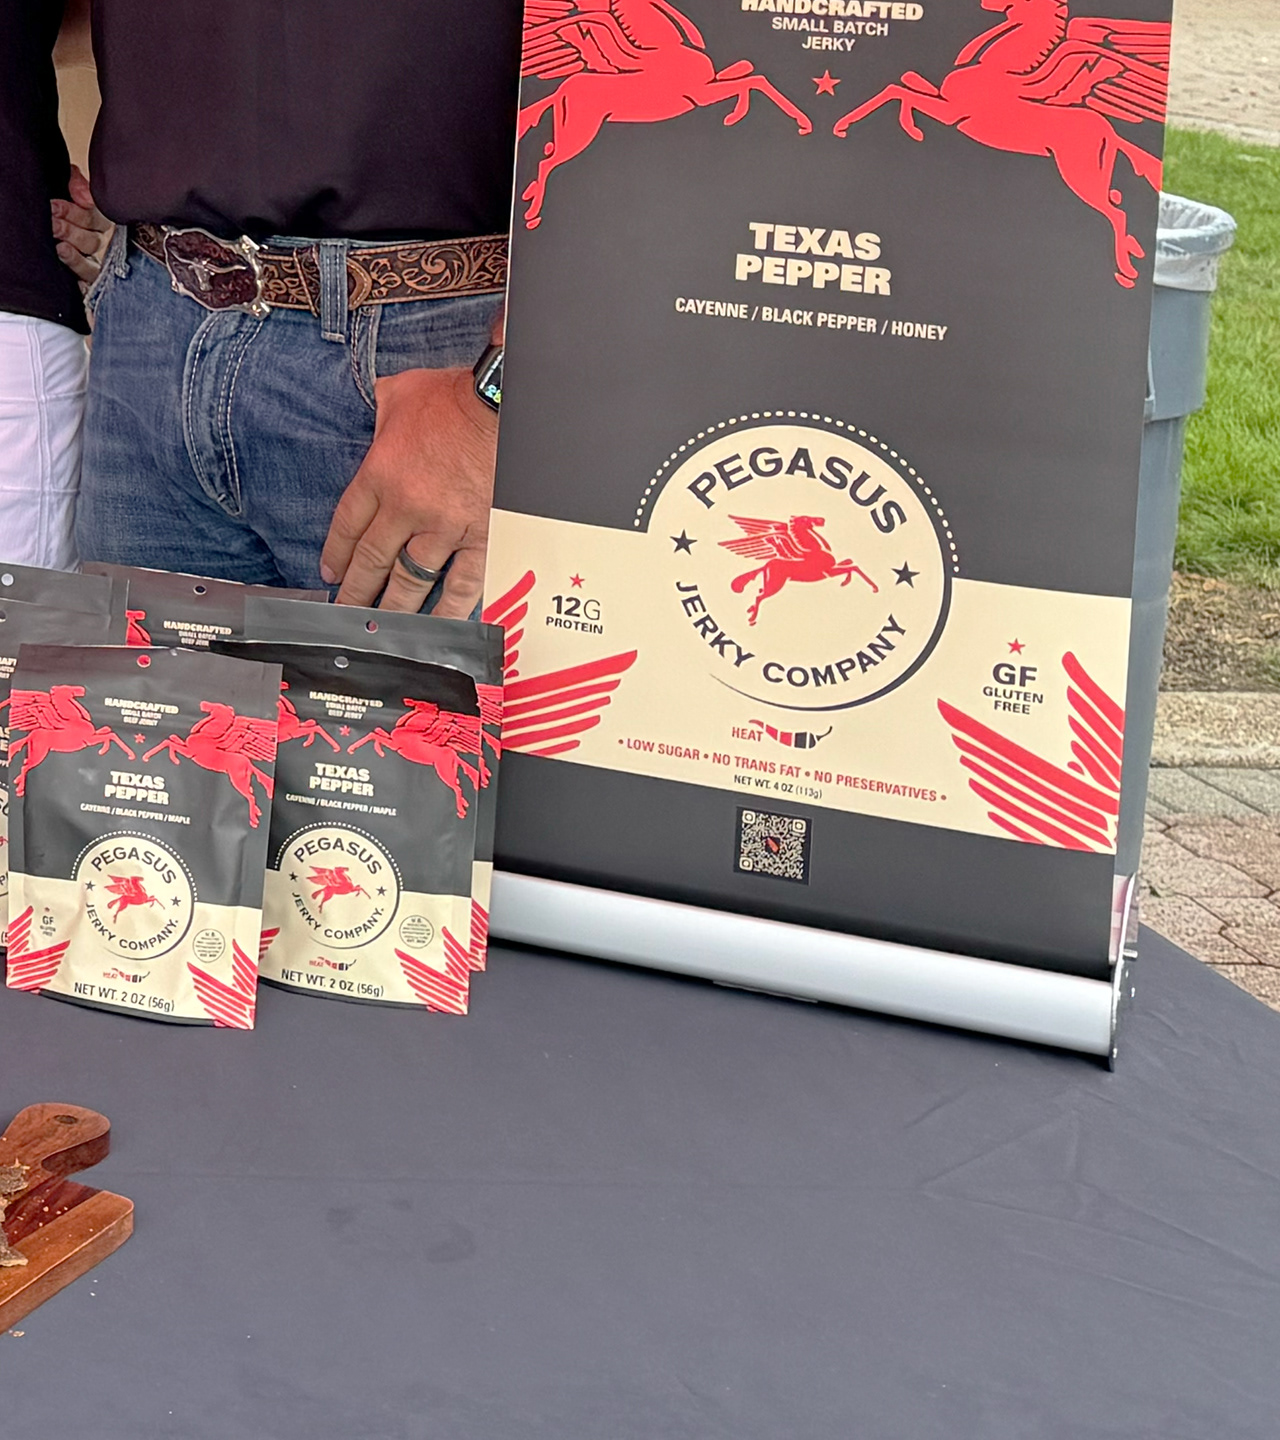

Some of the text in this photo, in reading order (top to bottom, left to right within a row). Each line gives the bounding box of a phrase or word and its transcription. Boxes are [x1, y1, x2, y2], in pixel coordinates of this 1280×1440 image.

[772, 16, 888, 36] SMALL BATCH
[802, 36, 855, 52] JERKY
[749, 222, 881, 260] TEXAS
[735, 254, 892, 295] PEPPER
[676, 298, 947, 340] CAYENNE BLACK PEPPER HONEY
[687, 447, 907, 533] PEGASUS
[552, 595, 601, 620] 12G
[546, 616, 603, 634] PROTEIN
[676, 581, 906, 687] JERKY COMPANY
[993, 663, 1037, 687] GF
[105, 698, 179, 715] HANDCRAFTED
[309, 691, 383, 708] HANDCRAFTED
[983, 686, 1043, 704] GLUTEN
[994, 700, 1030, 714] FREE
[732, 727, 763, 742] HEAT
[110, 771, 165, 790] TEXAS
[315, 763, 370, 781] TEXAS
[627, 738, 937, 802] LOW SUGAR NO TRANS FAT NO PRESERVATIVES
[104, 784, 169, 805] PEPPER
[309, 776, 374, 796] PEPPER
[734, 774, 752, 785] NET
[774, 782, 779, 790] 4
[781, 783, 793, 793] OZ
[795, 785, 822, 799] (113g)
[90, 846, 177, 884] PEGASUS
[294, 837, 382, 875] PEGASUS
[42, 916, 54, 925] GF
[86, 903, 116, 942] JERKY
[292, 891, 322, 931] JERKY
[281, 968, 302, 983] NET
[330, 977, 336, 989] 2
[339, 979, 354, 992] OZ
[357, 983, 384, 997] (56g)
[74, 982, 94, 996] NET
[121, 991, 127, 1002] 2
[131, 992, 145, 1006] OZ
[148, 995, 175, 1012] (56g)
